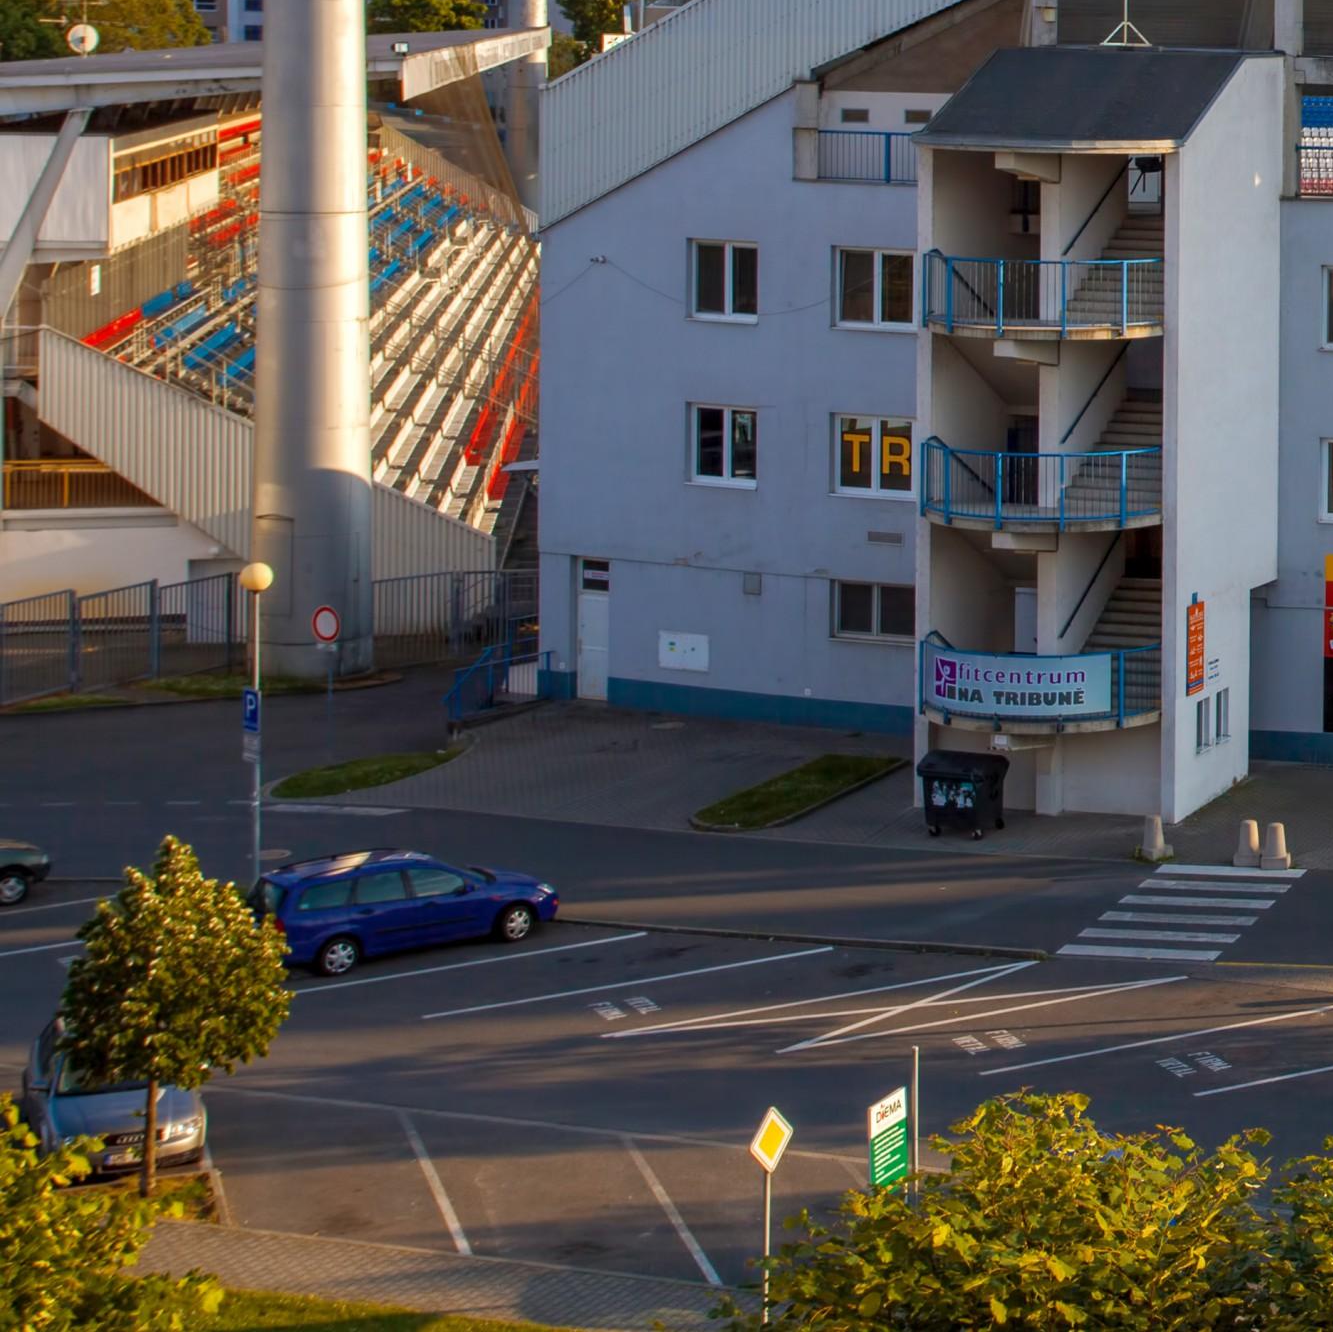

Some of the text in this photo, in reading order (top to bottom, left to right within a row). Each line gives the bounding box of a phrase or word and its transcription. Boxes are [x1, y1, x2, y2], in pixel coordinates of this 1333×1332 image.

[843, 433, 911, 476] TR
[958, 662, 1086, 685] fitcentrum
[246, 693, 257, 718] P
[957, 687, 1085, 706] NA TRIBUNĚ
